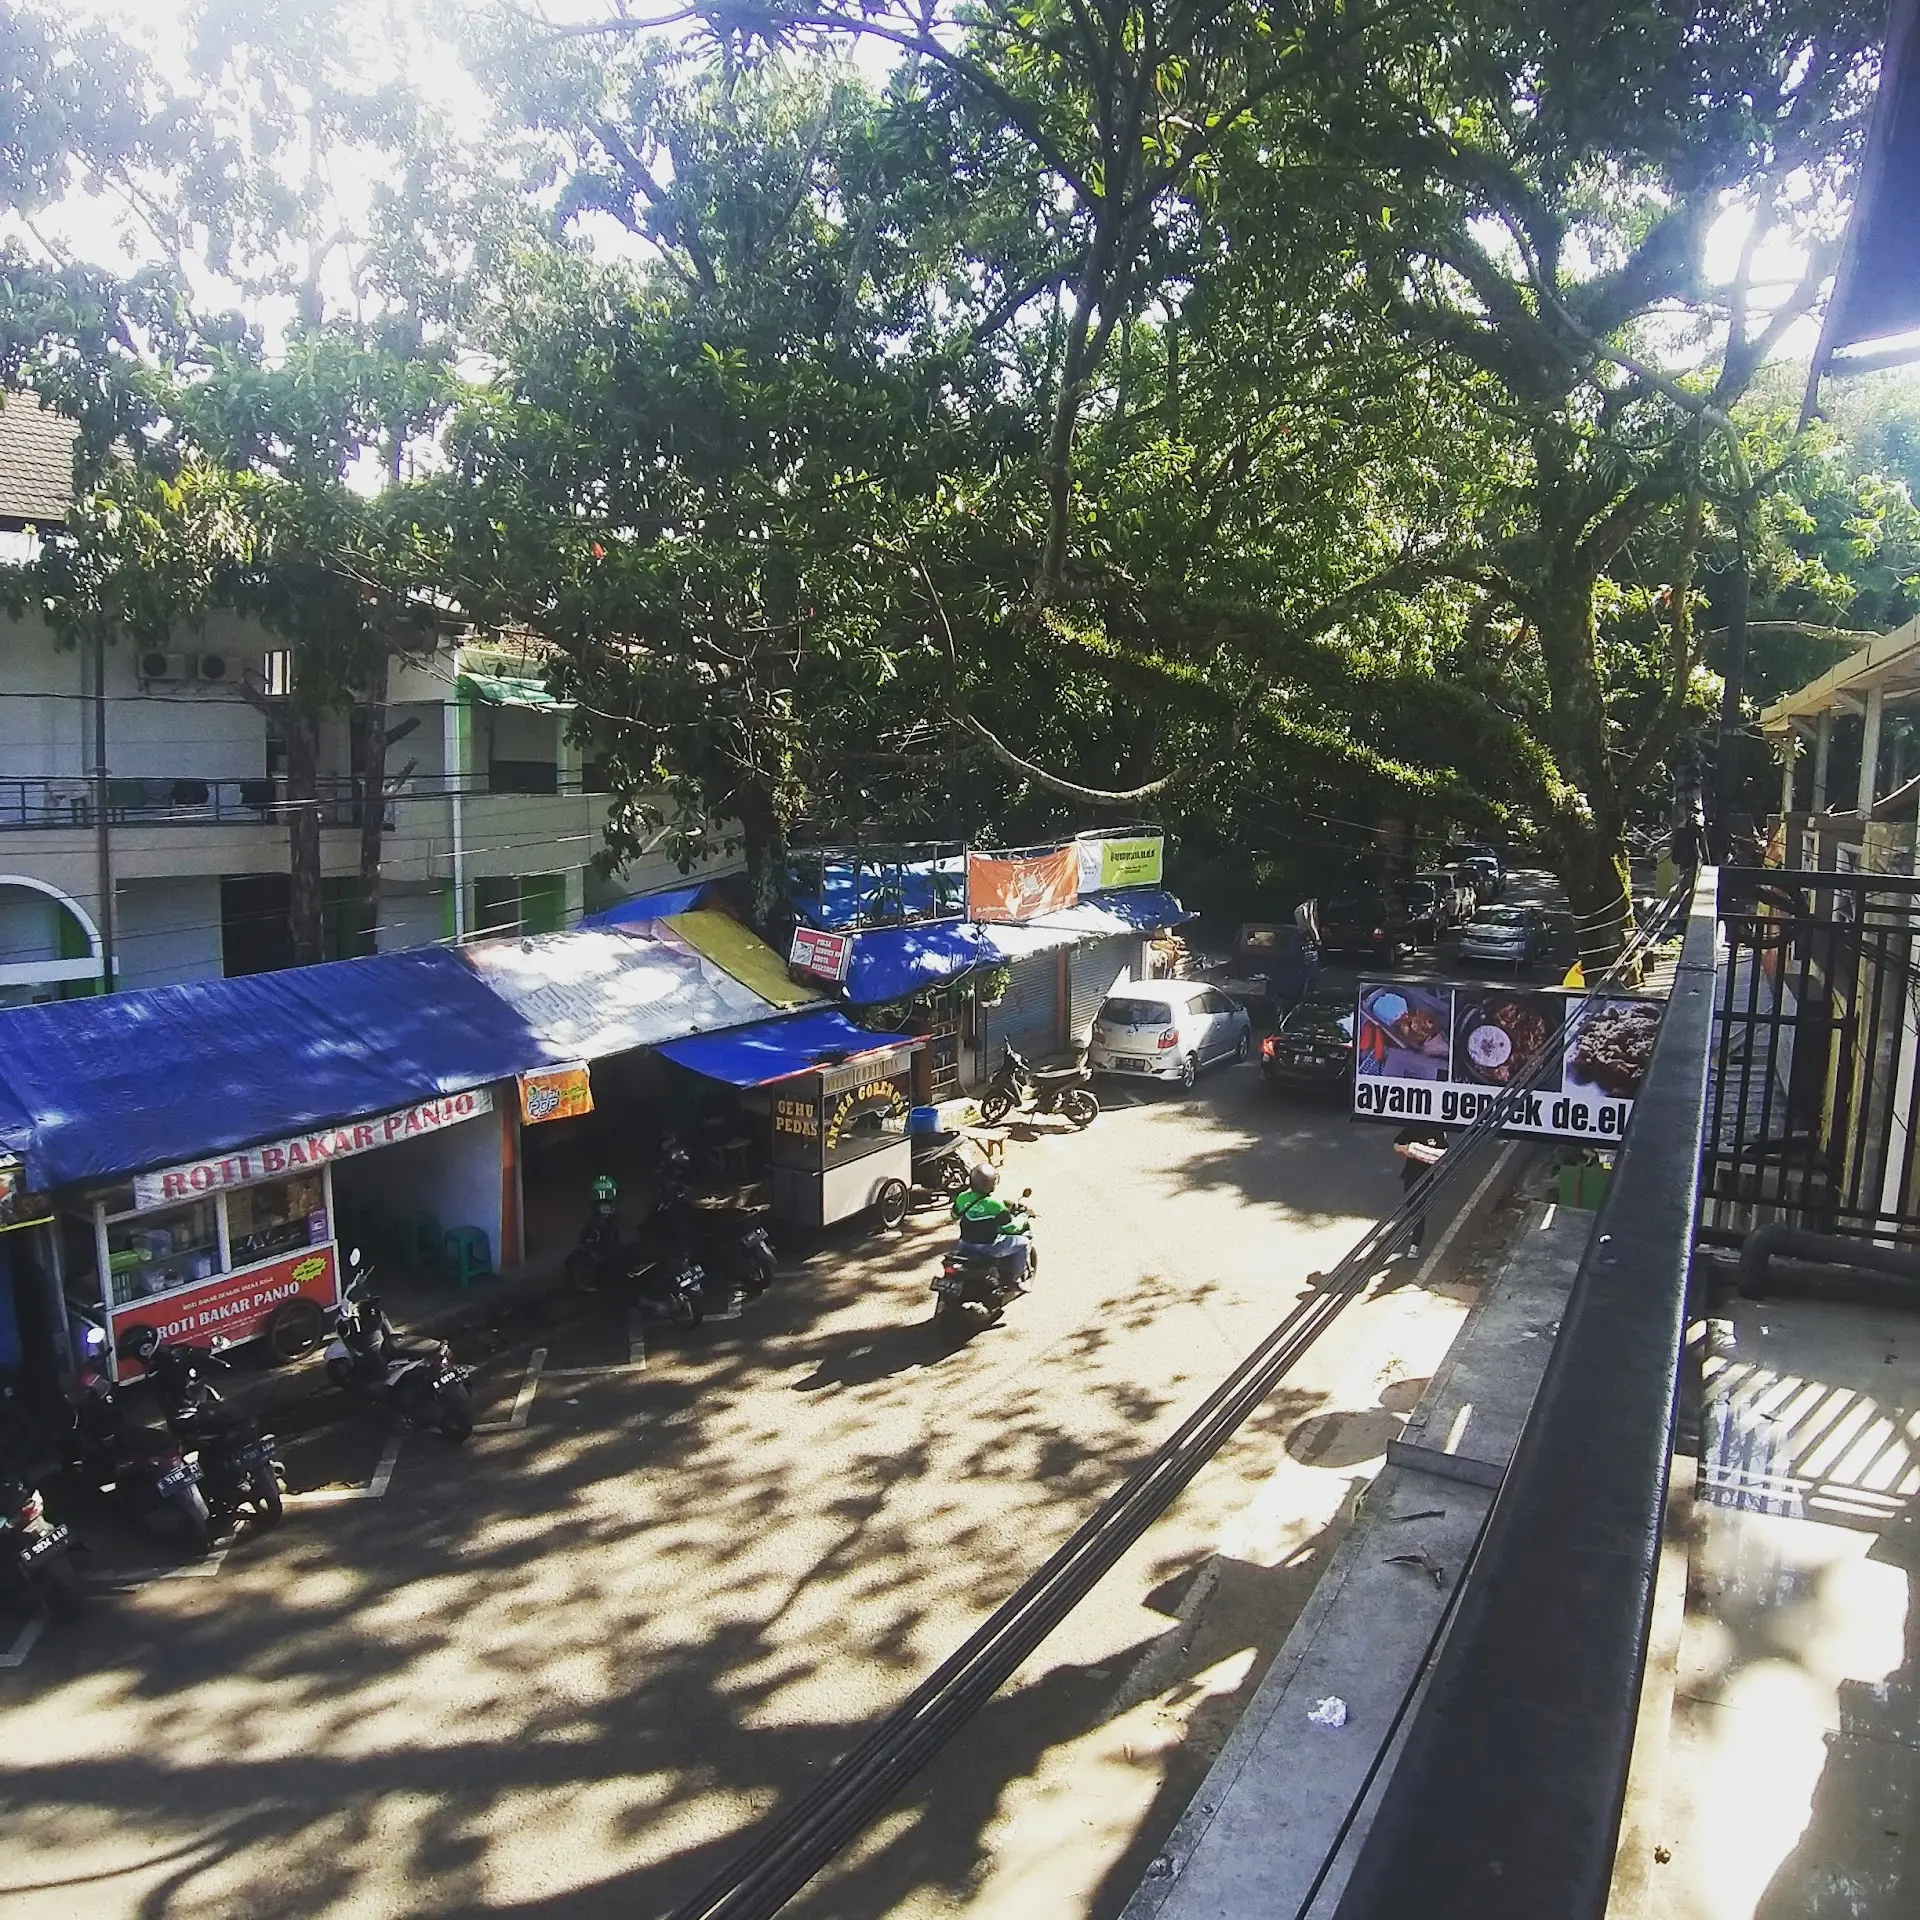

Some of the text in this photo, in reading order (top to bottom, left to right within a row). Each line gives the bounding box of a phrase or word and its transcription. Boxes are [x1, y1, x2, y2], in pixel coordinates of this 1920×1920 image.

[529, 1098, 559, 1116] POP
[778, 1099, 814, 1118] GEHU
[1357, 1082, 1432, 1115] ayam
[1441, 1090, 1542, 1127] gepek
[776, 1116, 819, 1137] PEDAS
[162, 1093, 474, 1200] ROTI BAKAR PANJO
[156, 1316, 195, 1341] ROTI
[199, 1298, 250, 1326] BAKAR
[253, 1281, 300, 1307] PANJO
